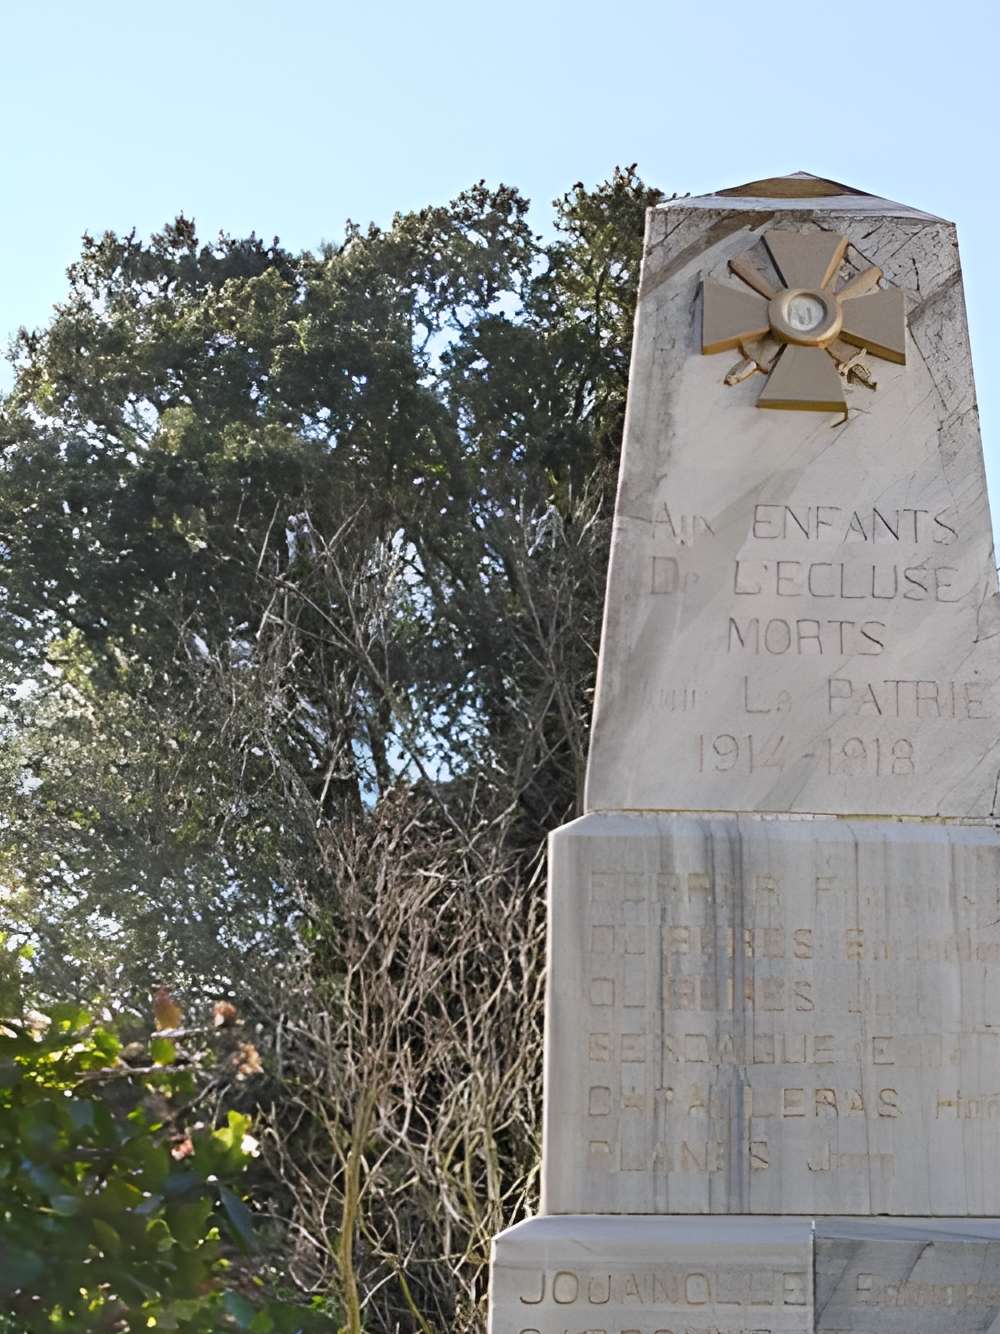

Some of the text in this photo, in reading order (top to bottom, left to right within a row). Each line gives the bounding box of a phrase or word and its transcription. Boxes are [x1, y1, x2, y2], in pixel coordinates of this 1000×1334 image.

[752, 503, 960, 546] ENFANTS
[733, 559, 961, 603] L'ECLUSE
[727, 616, 887, 656] MORTS
[827, 677, 992, 720] PATRIE
